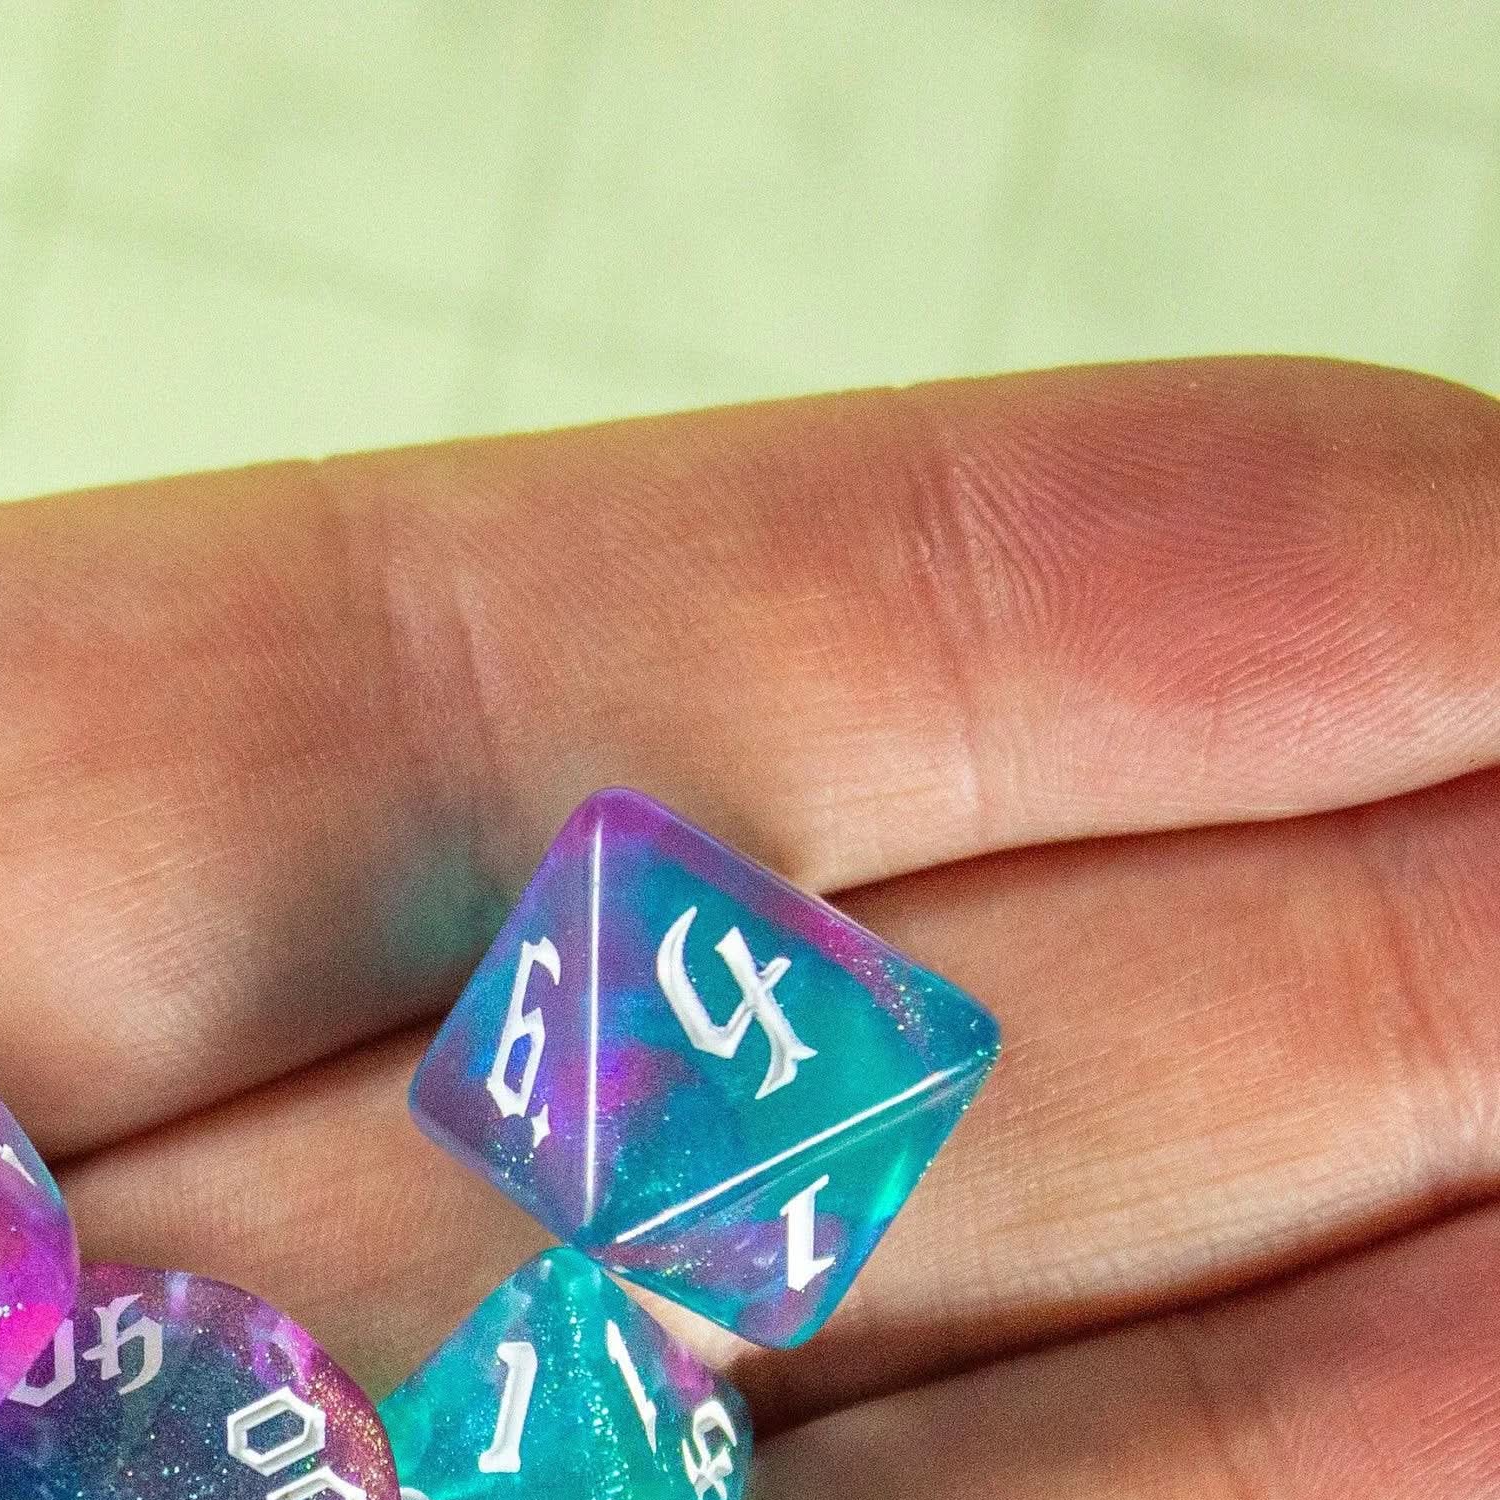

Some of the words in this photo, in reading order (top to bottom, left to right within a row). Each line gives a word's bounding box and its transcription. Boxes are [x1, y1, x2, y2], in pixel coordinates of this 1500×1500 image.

[656, 906, 819, 1101] 4
[780, 1174, 838, 1292] 1
[478, 1341, 538, 1474] 1
